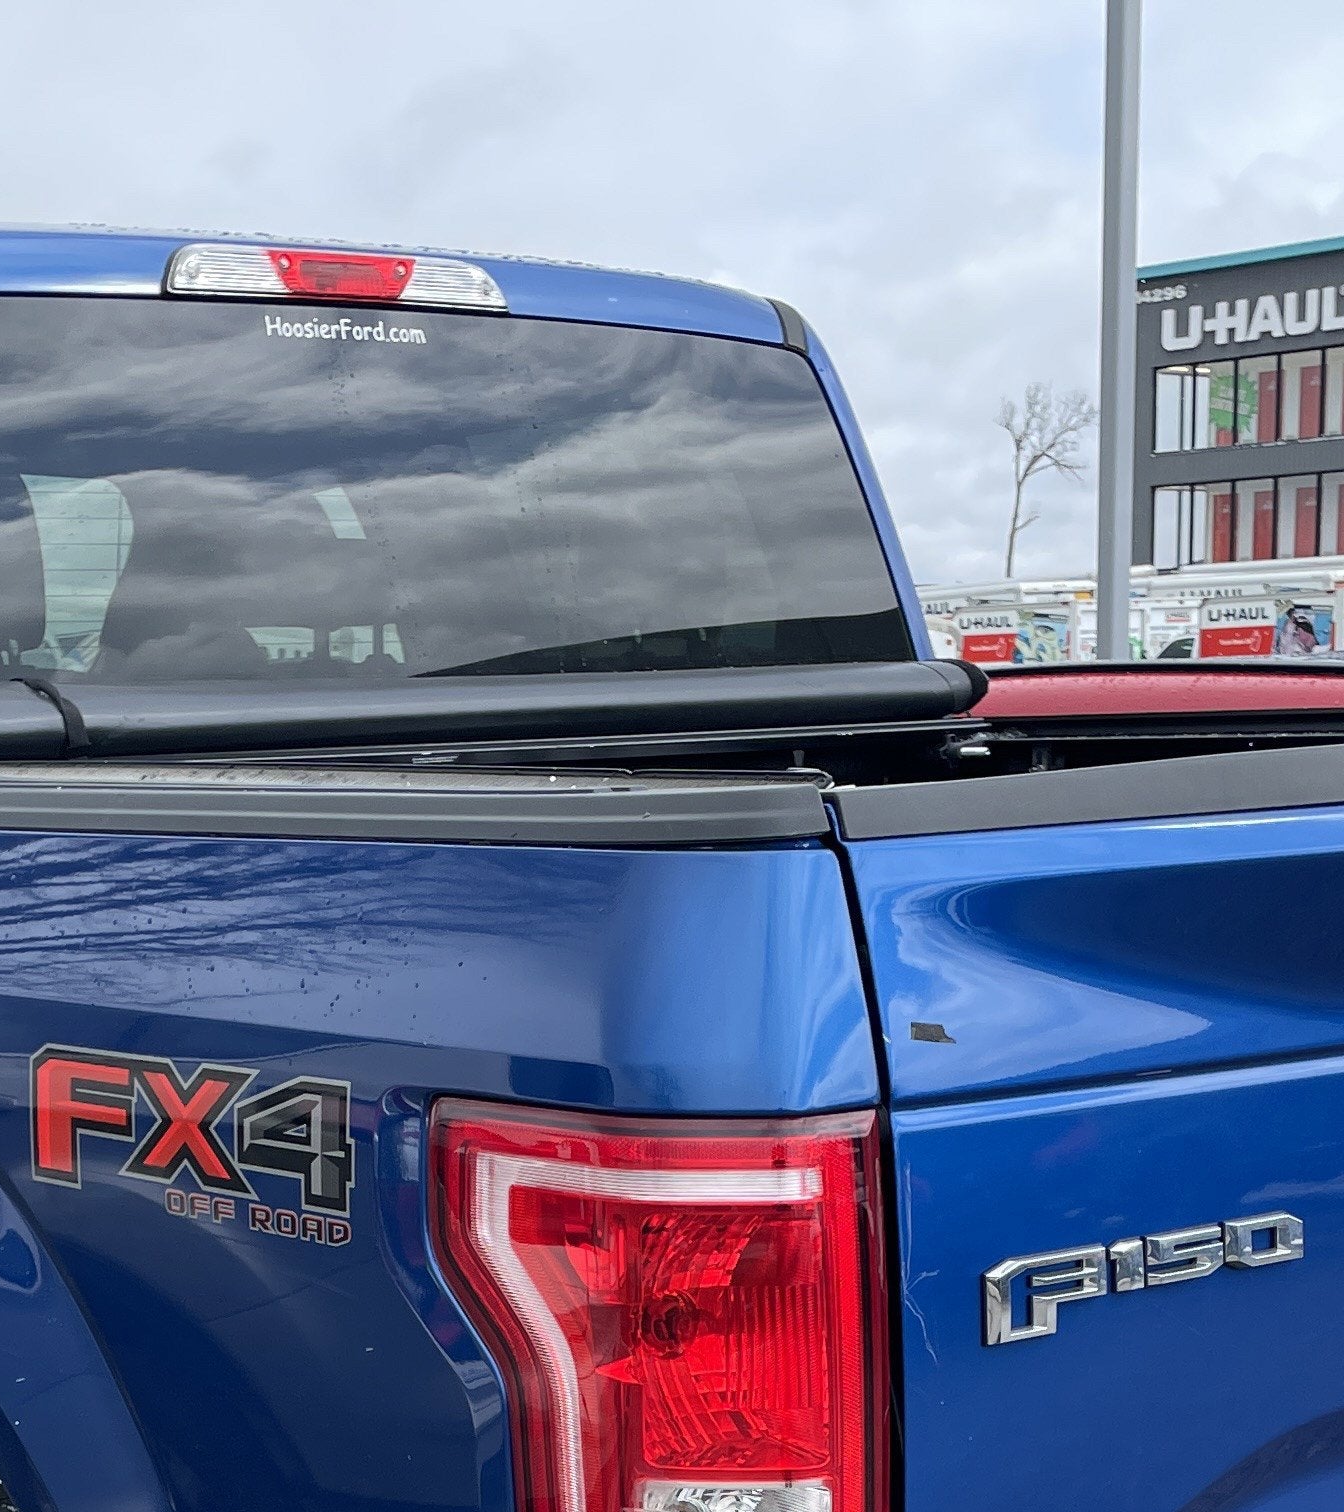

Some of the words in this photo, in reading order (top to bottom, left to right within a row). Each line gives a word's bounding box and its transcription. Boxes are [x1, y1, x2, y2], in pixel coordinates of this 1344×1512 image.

[264, 314, 428, 345] HoosierFord.com
[958, 615, 1013, 631] U-HAUL
[1207, 606, 1270, 622] U-HAUL
[30, 1043, 355, 1218] FX4
[164, 1187, 236, 1234] OFF
[248, 1202, 353, 1248] ROAD
[981, 1210, 1304, 1346] F150
